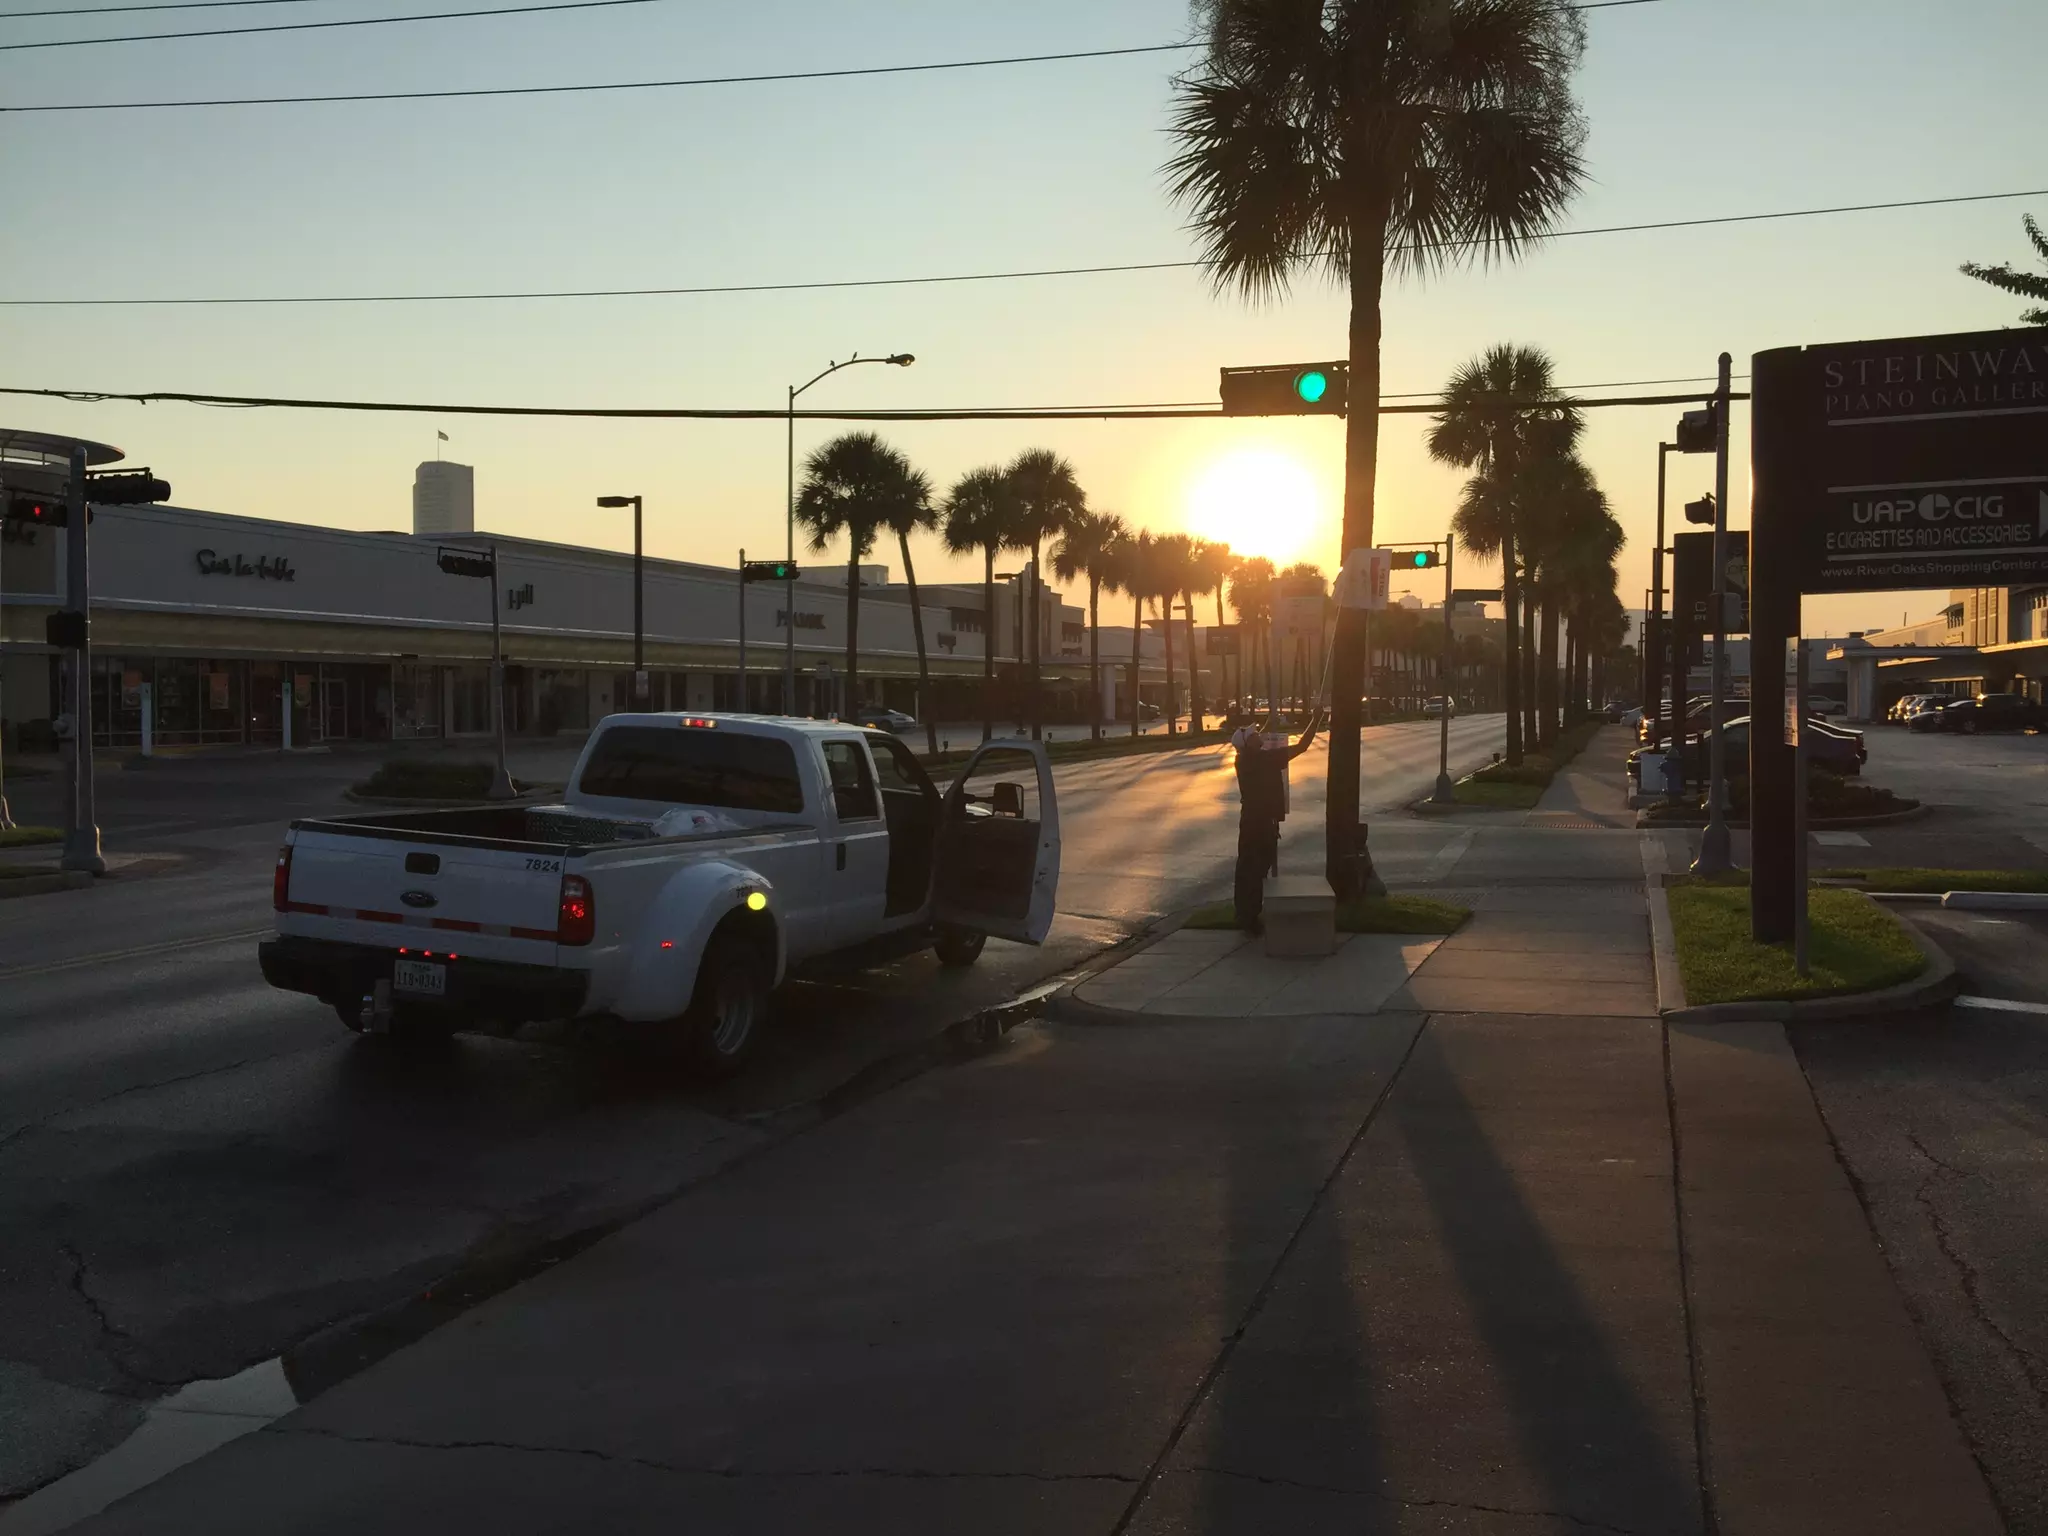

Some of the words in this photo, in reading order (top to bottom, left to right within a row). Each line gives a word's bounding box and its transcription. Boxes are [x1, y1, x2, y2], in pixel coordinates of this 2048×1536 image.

[1825, 345, 2048, 388] STEINWA
[1825, 389, 1914, 414] PIANO
[1837, 528, 1914, 549] CIGARETTES
[1916, 528, 1941, 546] AND
[1943, 523, 2032, 545] ACCESSORIES
[525, 858, 560, 873] 7824
